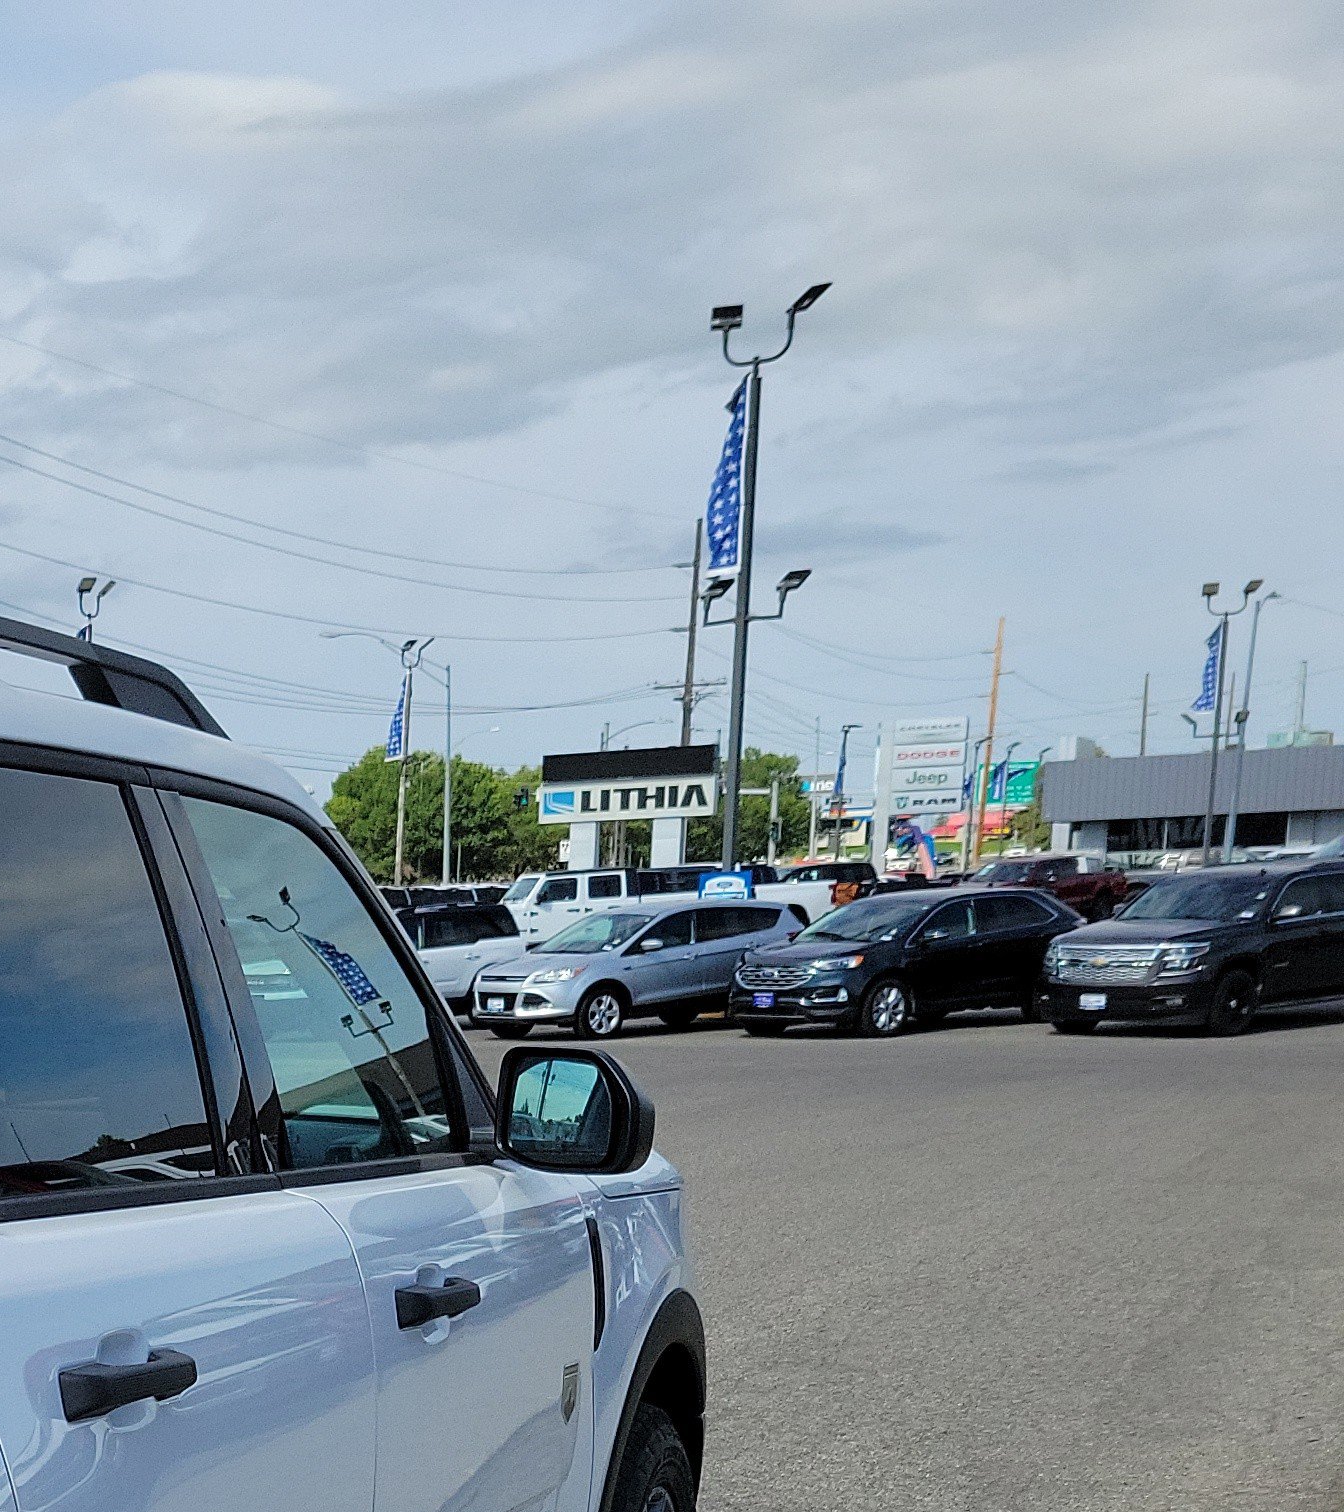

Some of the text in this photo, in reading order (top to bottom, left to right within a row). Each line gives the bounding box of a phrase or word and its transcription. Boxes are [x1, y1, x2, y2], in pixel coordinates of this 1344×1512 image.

[896, 748, 960, 761] DODGE
[906, 769, 948, 785] Jeep
[580, 784, 708, 813] LITHIA
[912, 797, 957, 807] RAM
